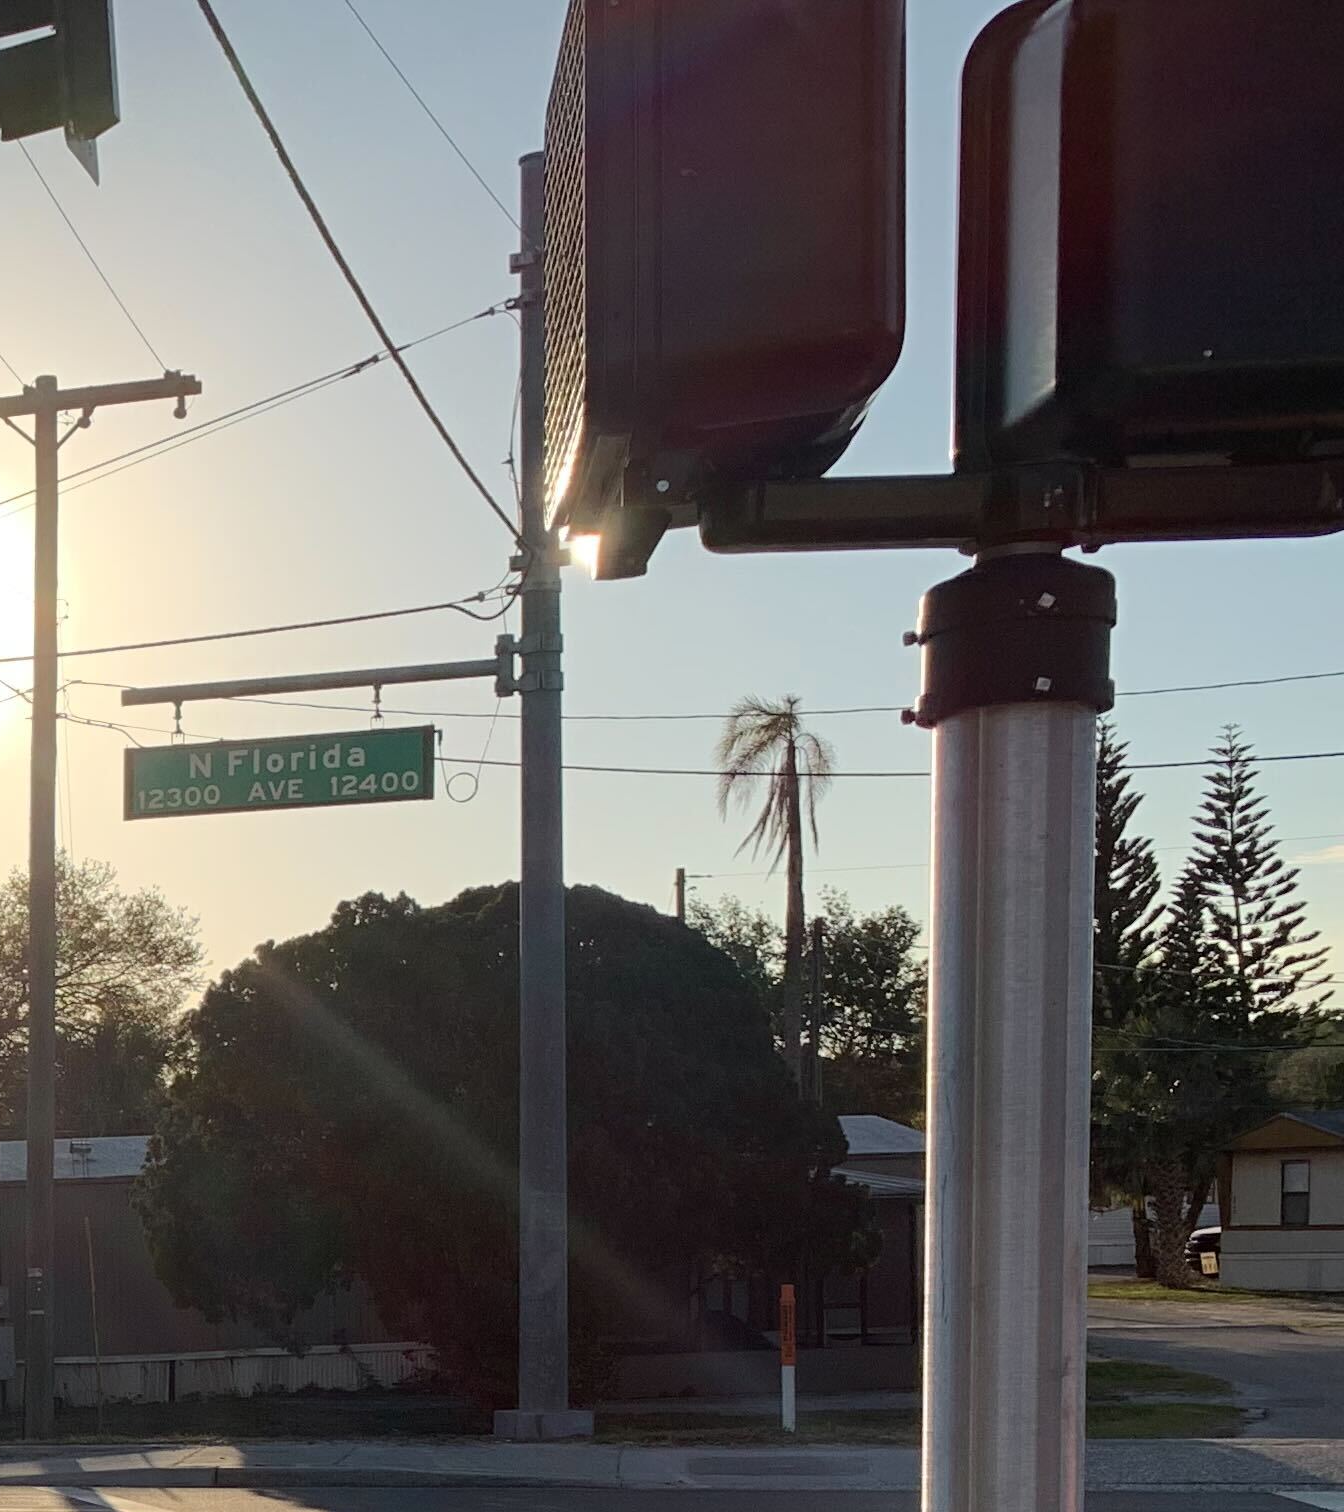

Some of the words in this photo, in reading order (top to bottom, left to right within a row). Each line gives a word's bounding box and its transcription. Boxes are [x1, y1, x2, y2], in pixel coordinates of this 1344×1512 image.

[188, 752, 211, 779] N
[227, 743, 366, 777] Florida
[137, 785, 221, 810] 12300
[247, 778, 304, 801] AVE
[330, 771, 419, 797] 12400
